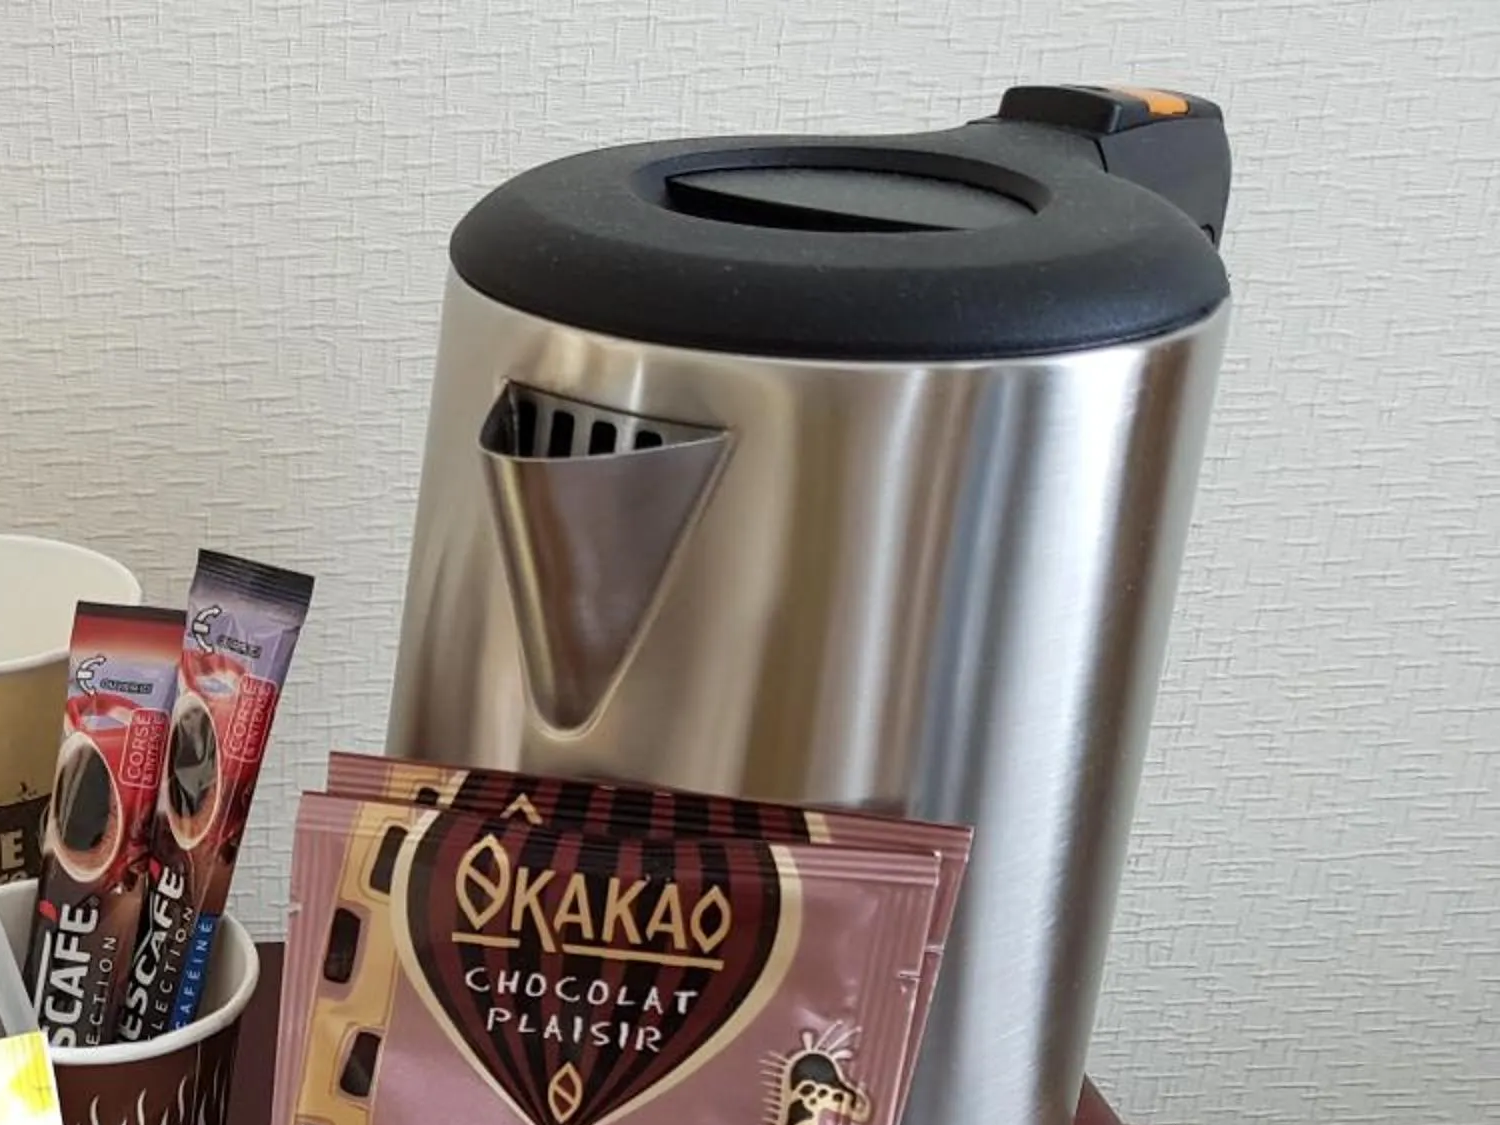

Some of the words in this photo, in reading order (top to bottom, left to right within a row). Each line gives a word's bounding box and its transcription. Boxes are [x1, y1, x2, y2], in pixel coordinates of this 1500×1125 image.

[39, 901, 98, 1047] SCAFÉ
[86, 936, 116, 1045] ECTION
[120, 864, 185, 1040] ESCAFÉ
[152, 907, 193, 1030] LECTION
[465, 967, 698, 1015] CHOCOLAT
[487, 1007, 662, 1051] PLAISIR
